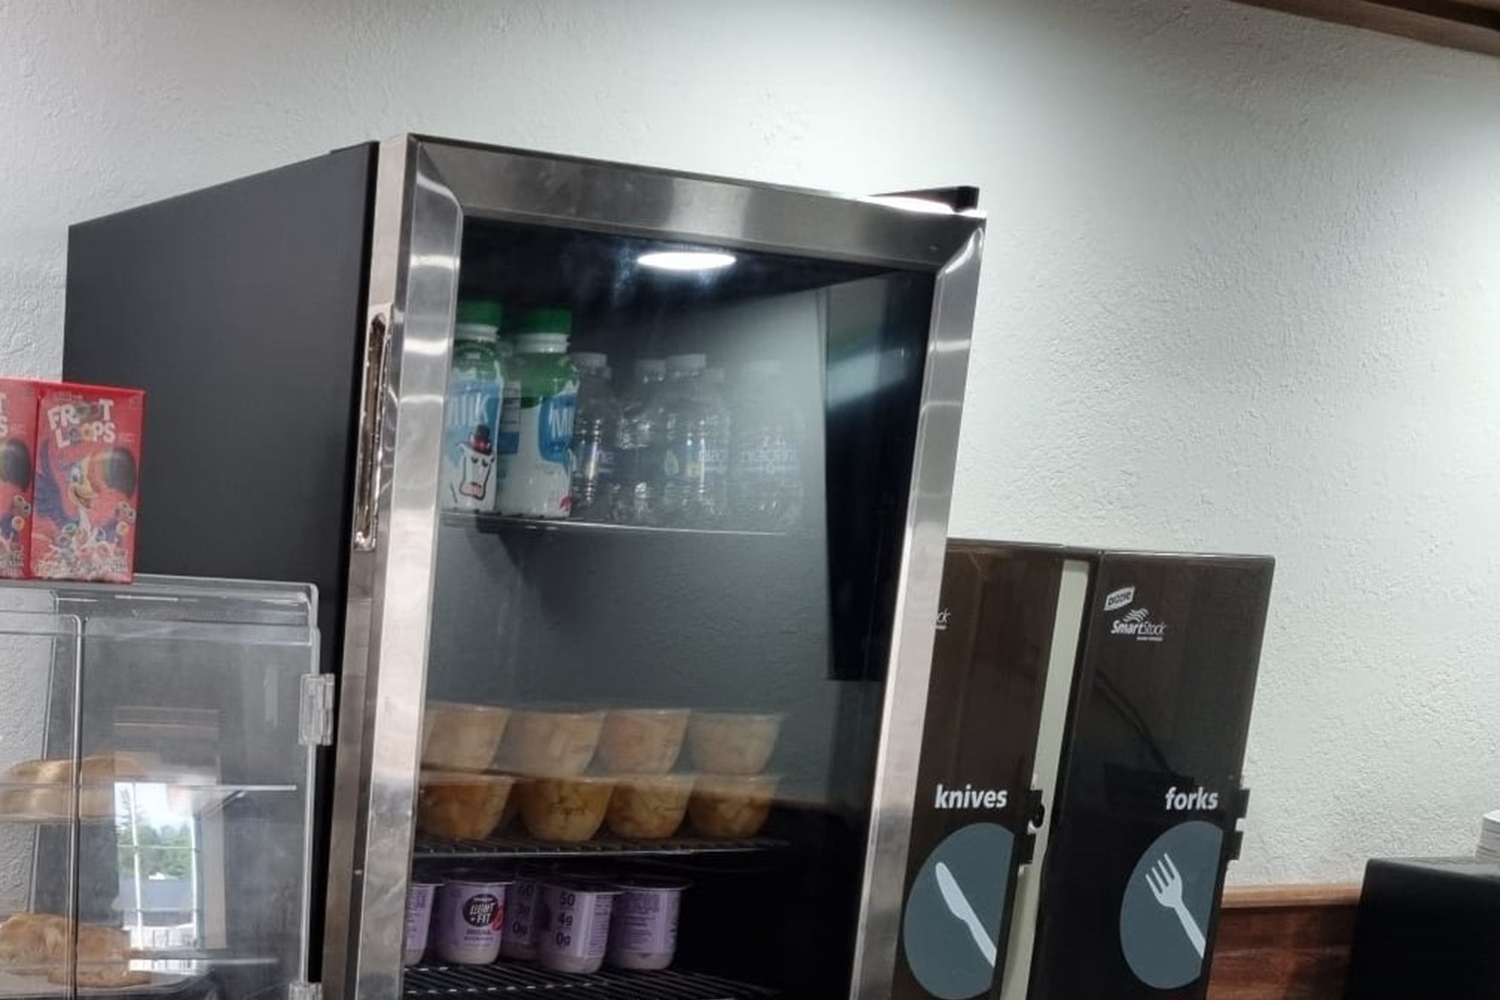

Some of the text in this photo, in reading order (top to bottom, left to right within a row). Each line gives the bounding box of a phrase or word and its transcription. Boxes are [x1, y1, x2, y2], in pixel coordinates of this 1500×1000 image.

[47, 399, 114, 430] FROOT
[55, 421, 115, 448] LOOPS
[934, 783, 1008, 809] knives
[1165, 786, 1219, 810] forks
